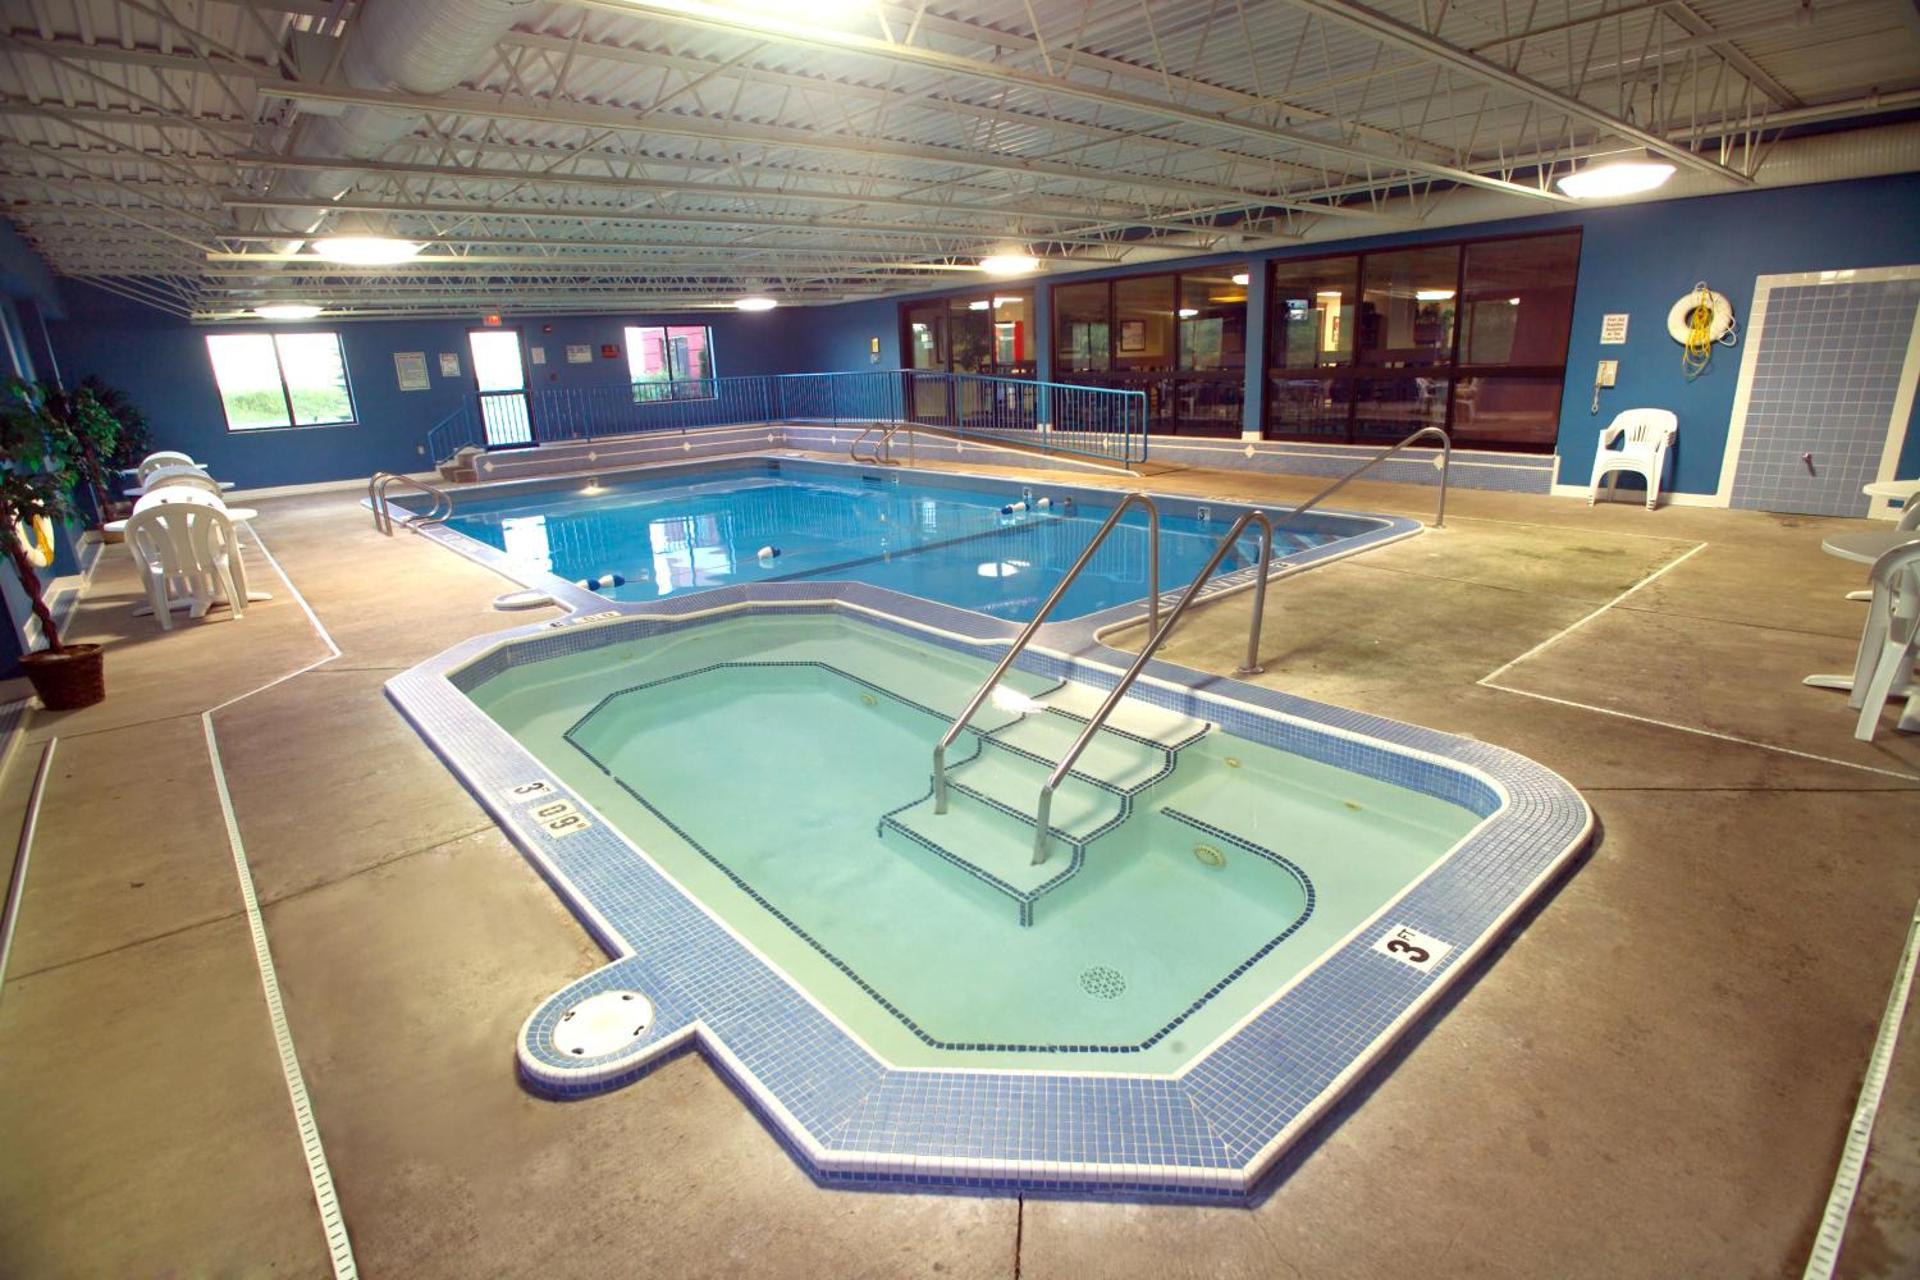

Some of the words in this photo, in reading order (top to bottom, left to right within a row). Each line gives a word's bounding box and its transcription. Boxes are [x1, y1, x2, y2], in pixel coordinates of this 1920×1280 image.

[514, 782, 544, 794] 3
[1397, 928, 1415, 941] FT
[1387, 940, 1430, 963] 3
